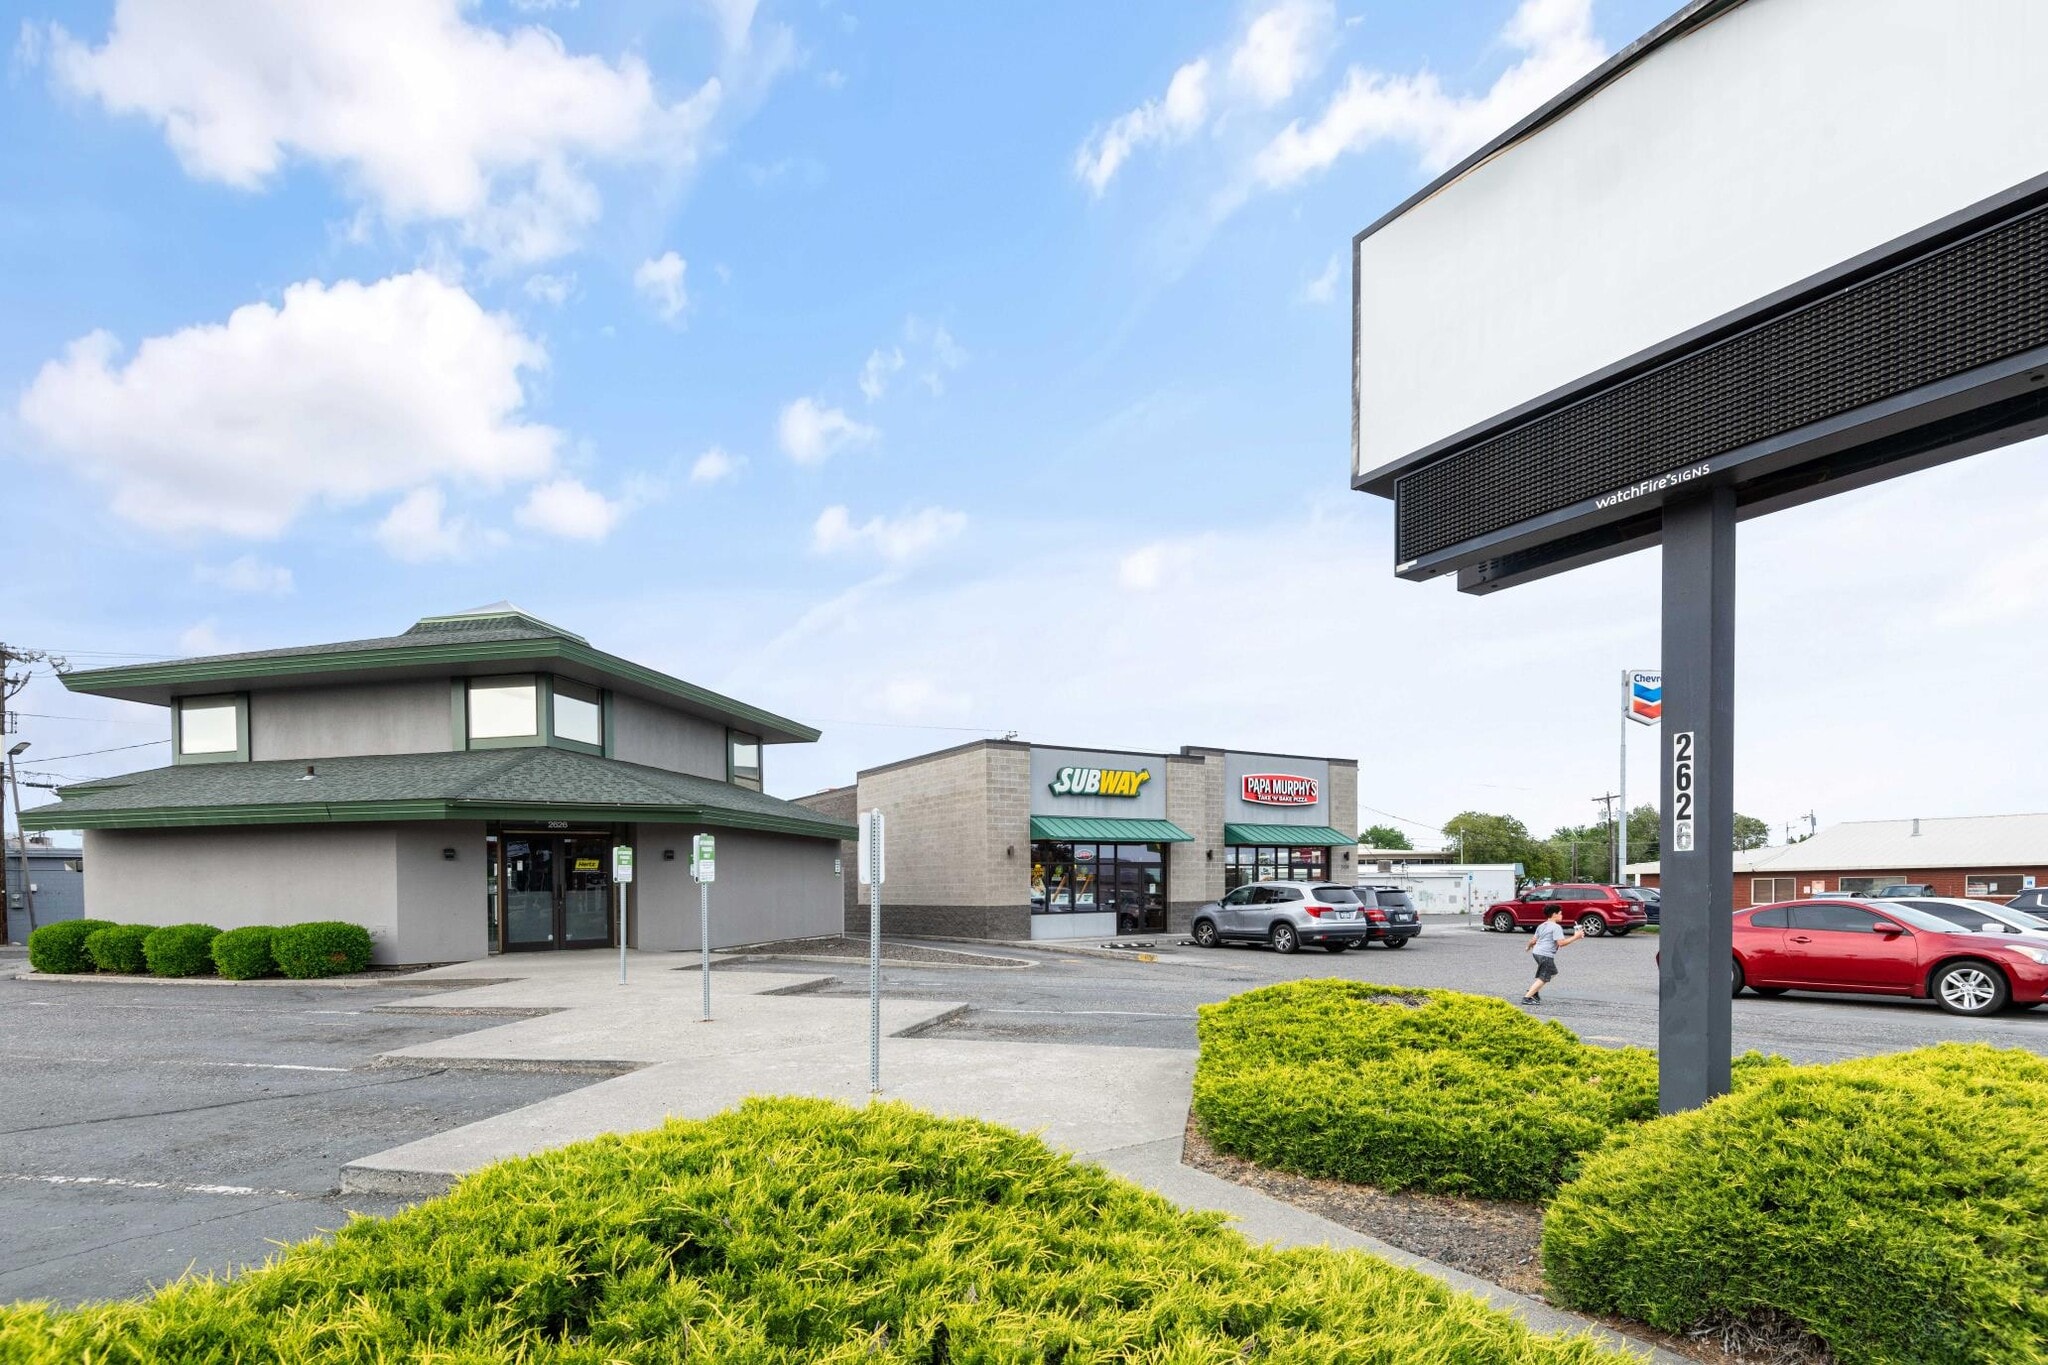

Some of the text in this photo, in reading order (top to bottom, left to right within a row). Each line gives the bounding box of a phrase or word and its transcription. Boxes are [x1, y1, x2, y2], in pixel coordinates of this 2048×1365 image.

[1670, 464, 1711, 486] SIGNS
[1634, 673, 1661, 683] Chevr
[1053, 767, 1150, 796] SUBWAY
[1247, 777, 1317, 797] PAPA MURPHY'S
[1676, 733, 1692, 850] 2626
